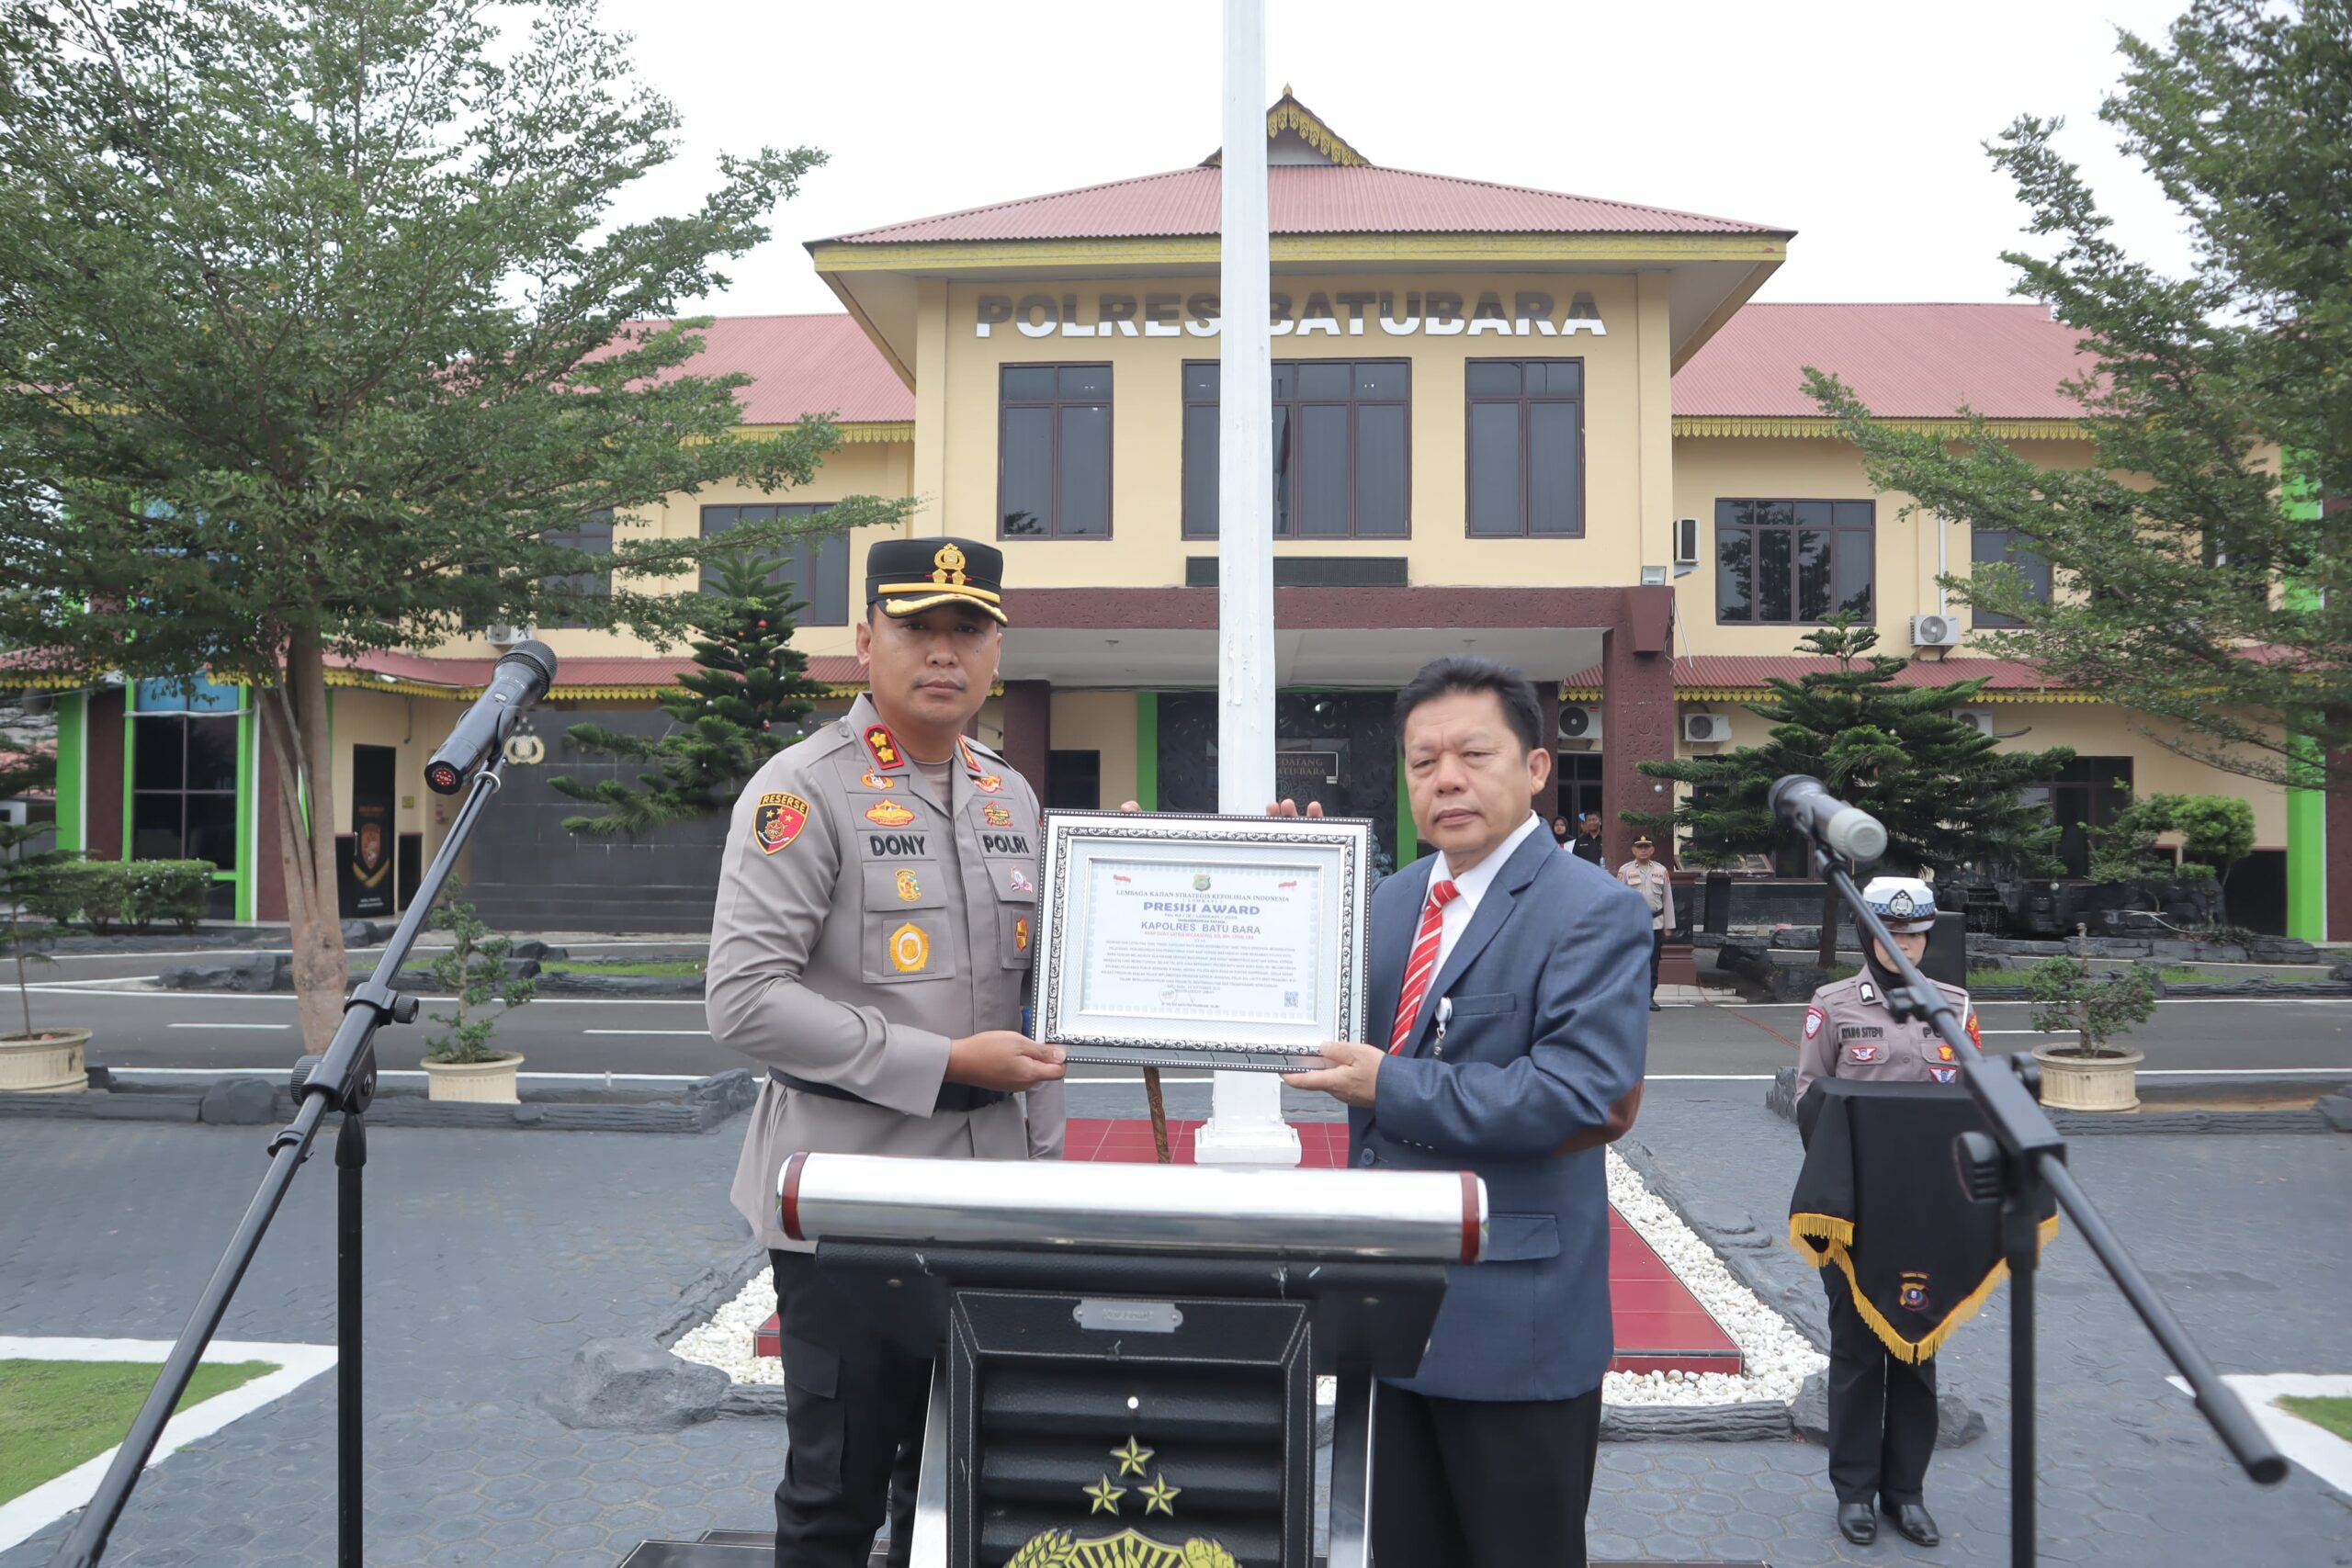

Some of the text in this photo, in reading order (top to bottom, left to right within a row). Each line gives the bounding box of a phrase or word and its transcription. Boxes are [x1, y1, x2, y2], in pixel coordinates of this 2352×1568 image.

[976, 291, 1607, 338] POLRES BATUBARA
[763, 795, 806, 813] RESERSE
[869, 835, 925, 856] DONY
[982, 834, 1030, 854] POLRI
[1143, 901, 1261, 915] PRESISI AWARD
[1141, 921, 1261, 934] KAPOLRES BATU BARA
